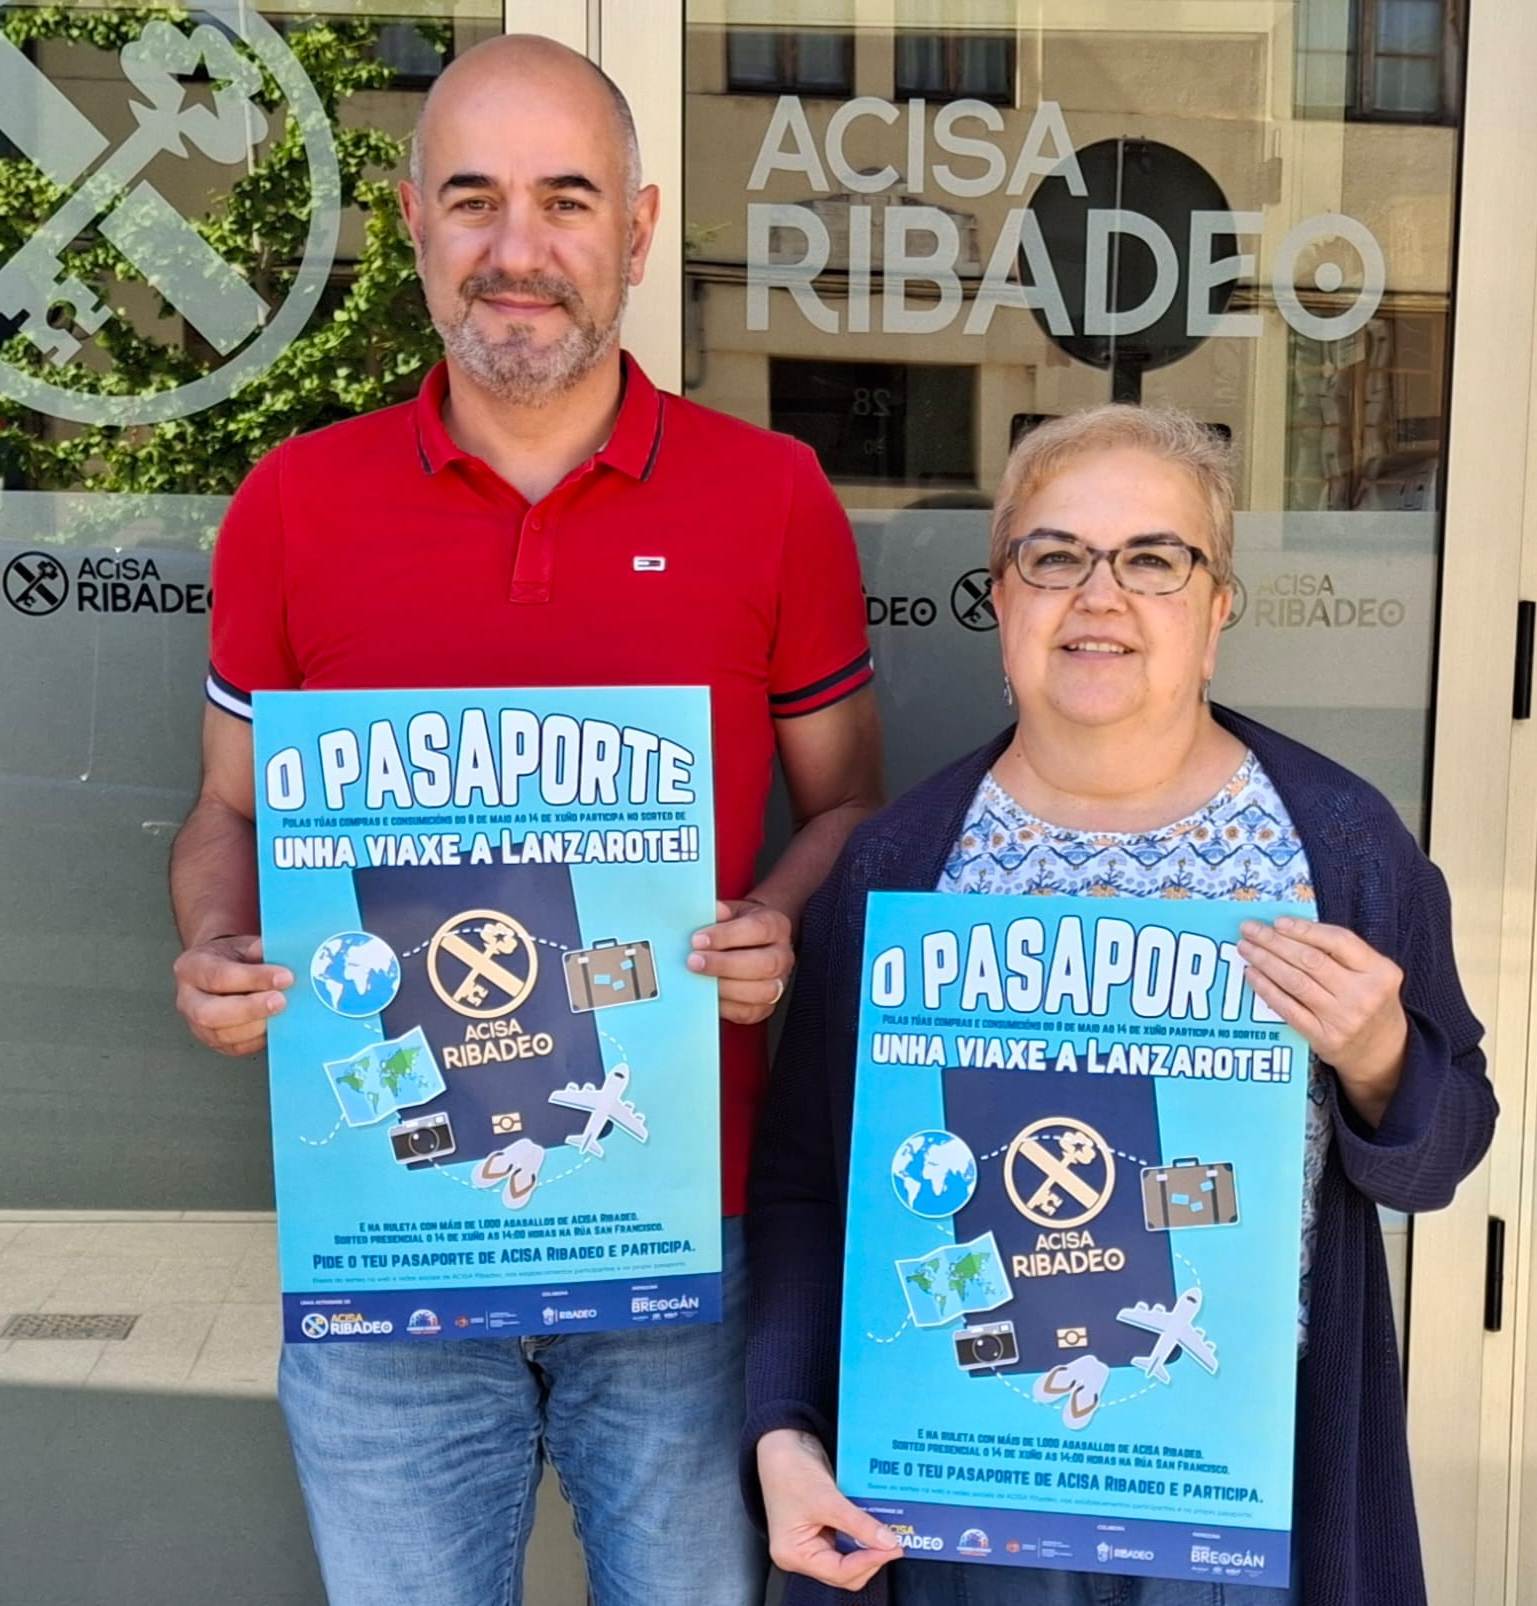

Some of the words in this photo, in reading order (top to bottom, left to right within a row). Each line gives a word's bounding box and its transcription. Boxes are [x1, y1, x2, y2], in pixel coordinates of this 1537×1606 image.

[746, 95, 1089, 197] ACISA
[746, 203, 1385, 341] RIBADEO
[77, 582, 213, 614] RIBADE
[1257, 574, 1335, 596] ACISA
[1254, 598, 1406, 628] RIBADEO
[265, 746, 307, 811] O
[317, 707, 696, 811] PASAPORTE
[580, 812, 625, 822] PARTICIPA
[273, 835, 358, 870] UNHA
[364, 832, 462, 868] VIAXE
[470, 832, 494, 866] A
[500, 825, 699, 865] LANZAROTE!!
[871, 945, 907, 1009] O
[465, 1018, 523, 1042] ACISA
[1169, 1026, 1216, 1038] PARTICIPA
[442, 1033, 553, 1070] RIBADEO
[871, 1032, 948, 1068] UNHA
[955, 1035, 1048, 1072] VIAXE
[1054, 1040, 1079, 1073] A
[1087, 1036, 1293, 1083] LANZAROTE!!
[313, 1253, 343, 1269] PIDE
[348, 1254, 357, 1268] O
[361, 1253, 388, 1268] TEU
[392, 1251, 475, 1267] PASAPORTE
[479, 1250, 496, 1265] DE
[501, 1247, 543, 1264] ACISA
[546, 1245, 605, 1262] RIBADEO
[609, 1244, 617, 1258] E
[621, 1239, 696, 1256] PARTICIPA.
[1036, 1230, 1095, 1251] ACISA
[1012, 1248, 1125, 1278] RIBADEO
[330, 1321, 393, 1336] RIBADEO
[331, 1313, 364, 1323] ACISA
[559, 1308, 597, 1320] RIBADEO
[869, 1458, 900, 1476] PIDE
[903, 1461, 913, 1477] O
[917, 1463, 943, 1479] TEU
[947, 1465, 1030, 1486] PASAPORTE
[1034, 1471, 1053, 1487] DE
[1056, 1471, 1100, 1491] ACISA
[1104, 1475, 1165, 1495] RIBADEO
[1169, 1482, 1178, 1497] E
[1183, 1483, 1264, 1504] PARTICIPA.
[1114, 1548, 1155, 1561] RIBADEO
